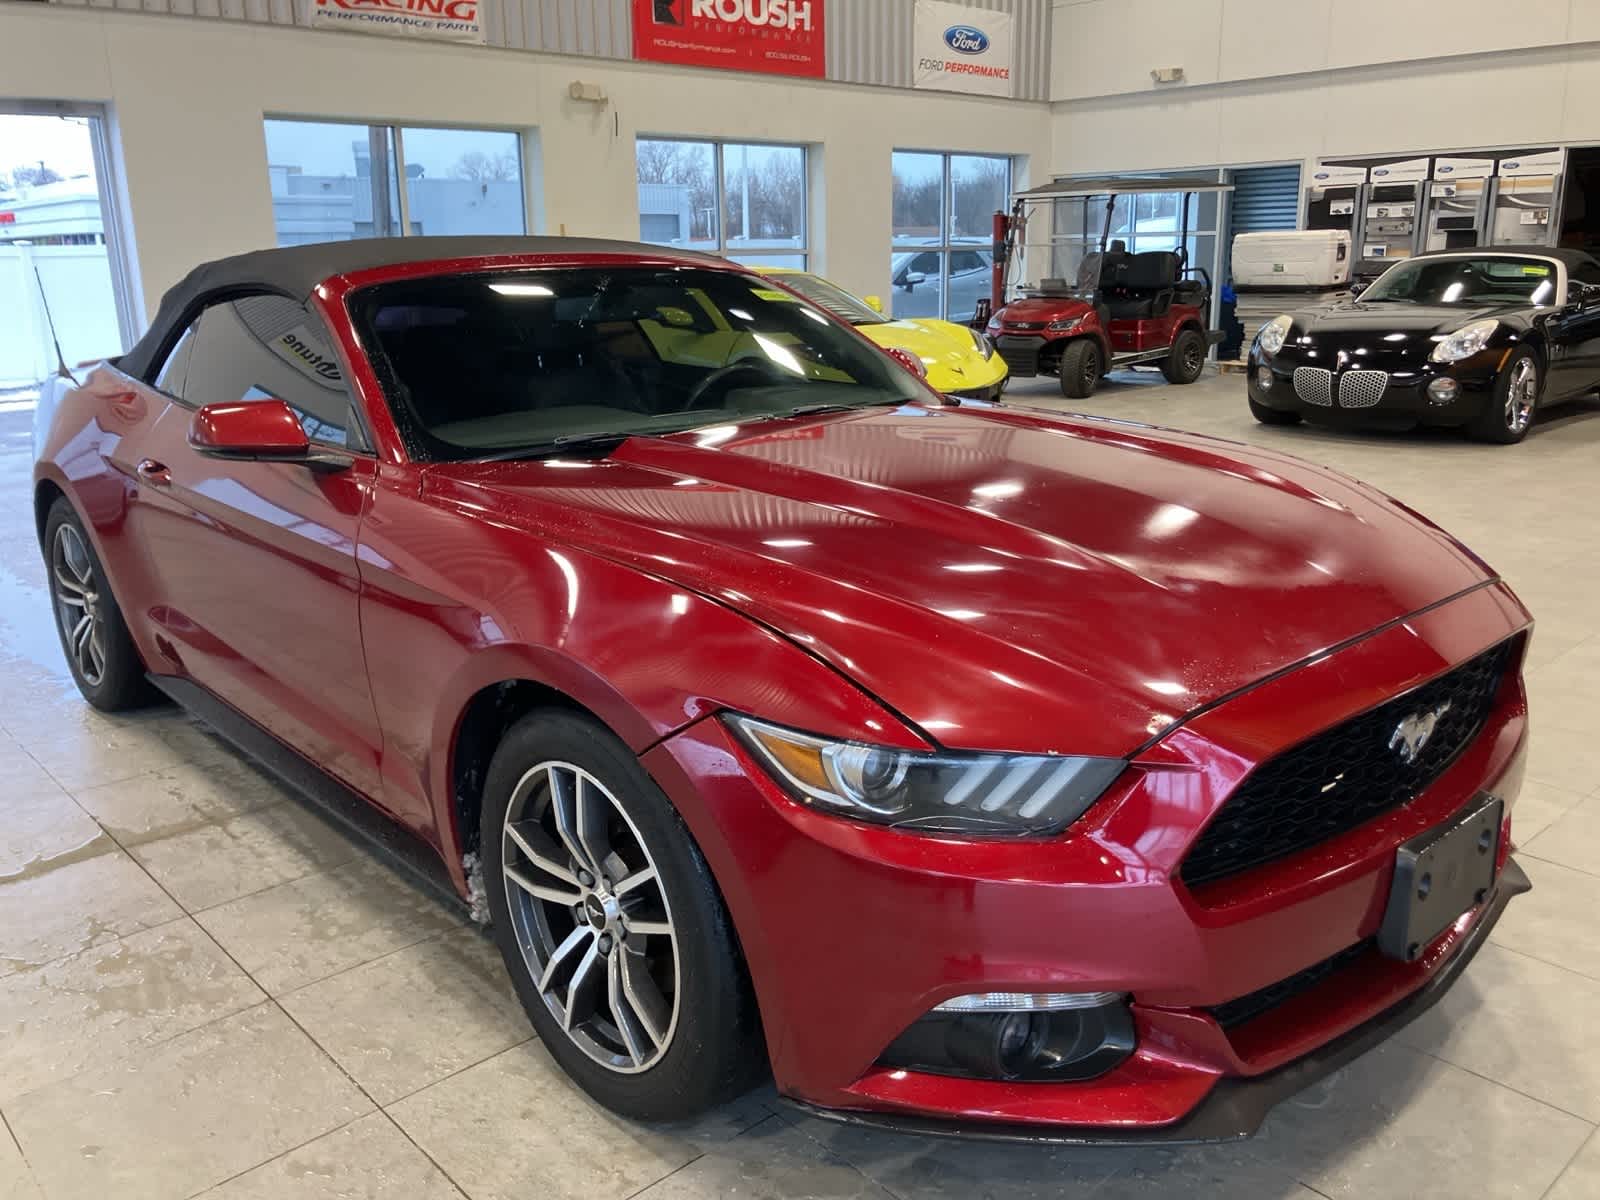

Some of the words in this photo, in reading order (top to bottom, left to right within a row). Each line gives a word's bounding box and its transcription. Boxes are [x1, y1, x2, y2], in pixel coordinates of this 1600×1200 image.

[317, 9, 433, 28] PERFORMANCE
[436, 22, 479, 32] PARTS
[692, 0, 812, 30] ROUSH
[693, 21, 812, 44] PERFORMANCE
[952, 29, 981, 50] Ford
[919, 58, 943, 71] FORD
[944, 61, 1009, 79] PERFORMANCE
